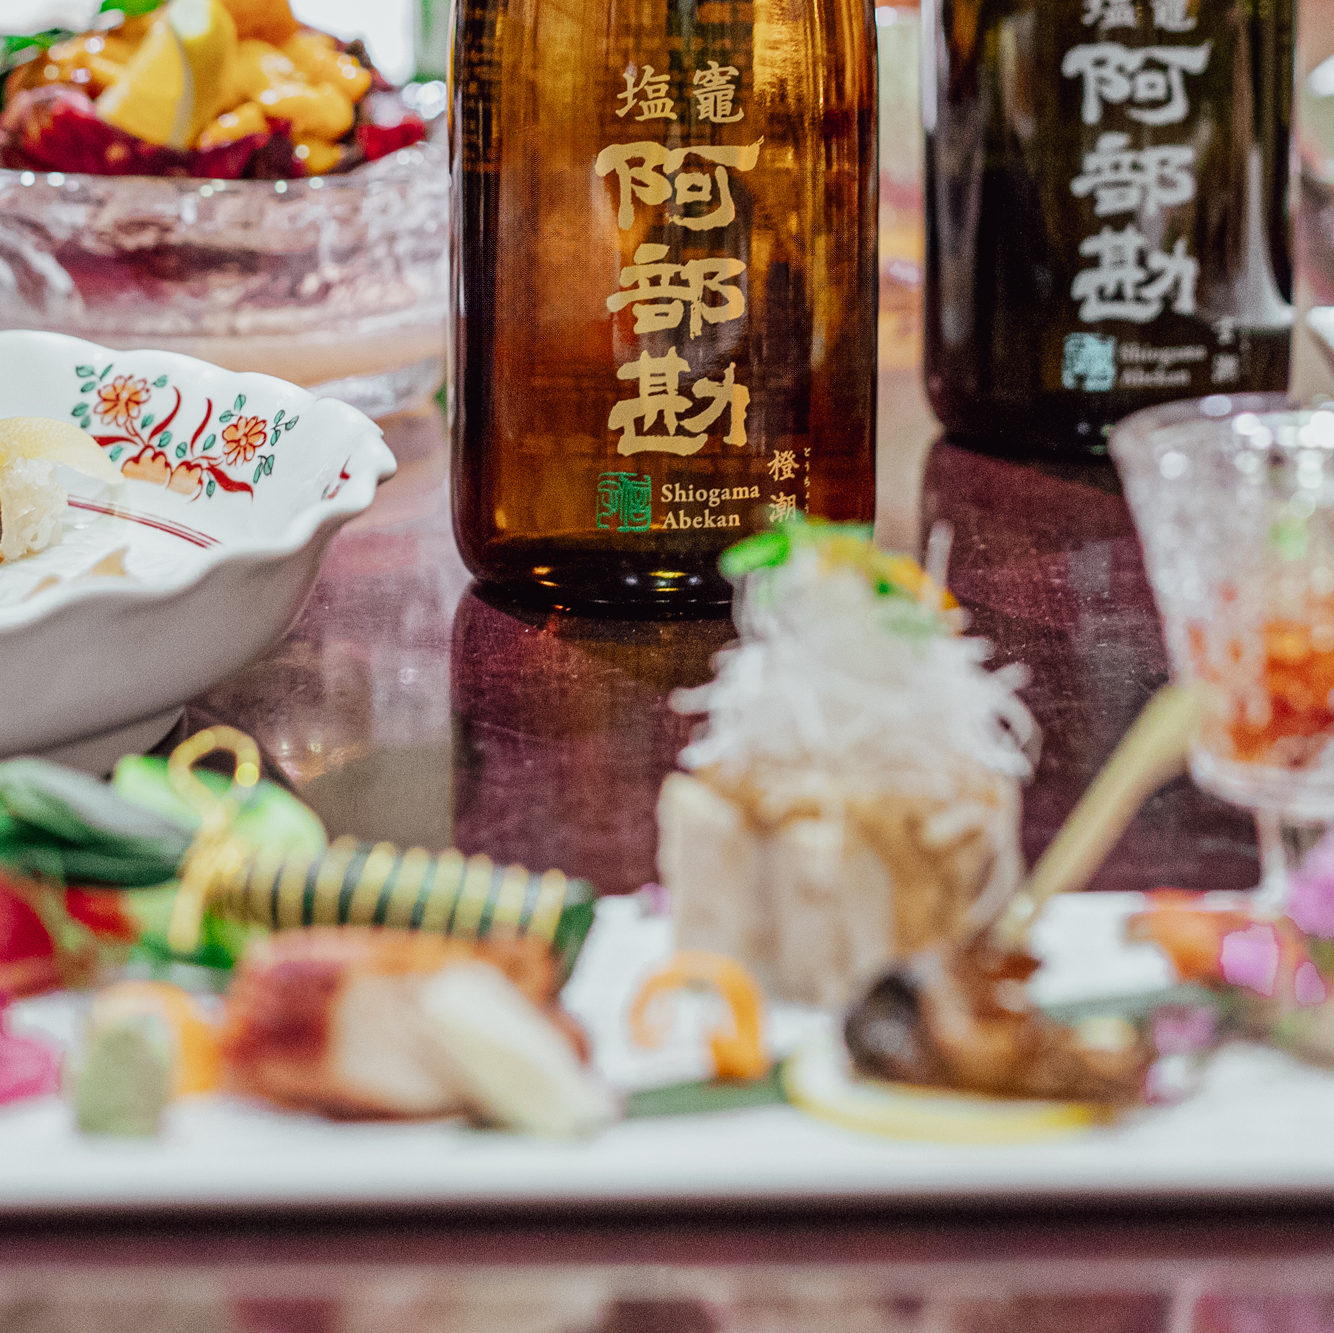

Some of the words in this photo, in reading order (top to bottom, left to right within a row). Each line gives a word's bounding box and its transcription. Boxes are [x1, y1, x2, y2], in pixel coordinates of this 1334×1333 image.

[1061, 40, 1213, 324] 阿部勘
[594, 135, 765, 458] 阿部勘
[660, 483, 761, 507] Shiogama
[662, 509, 741, 529] Abekan
